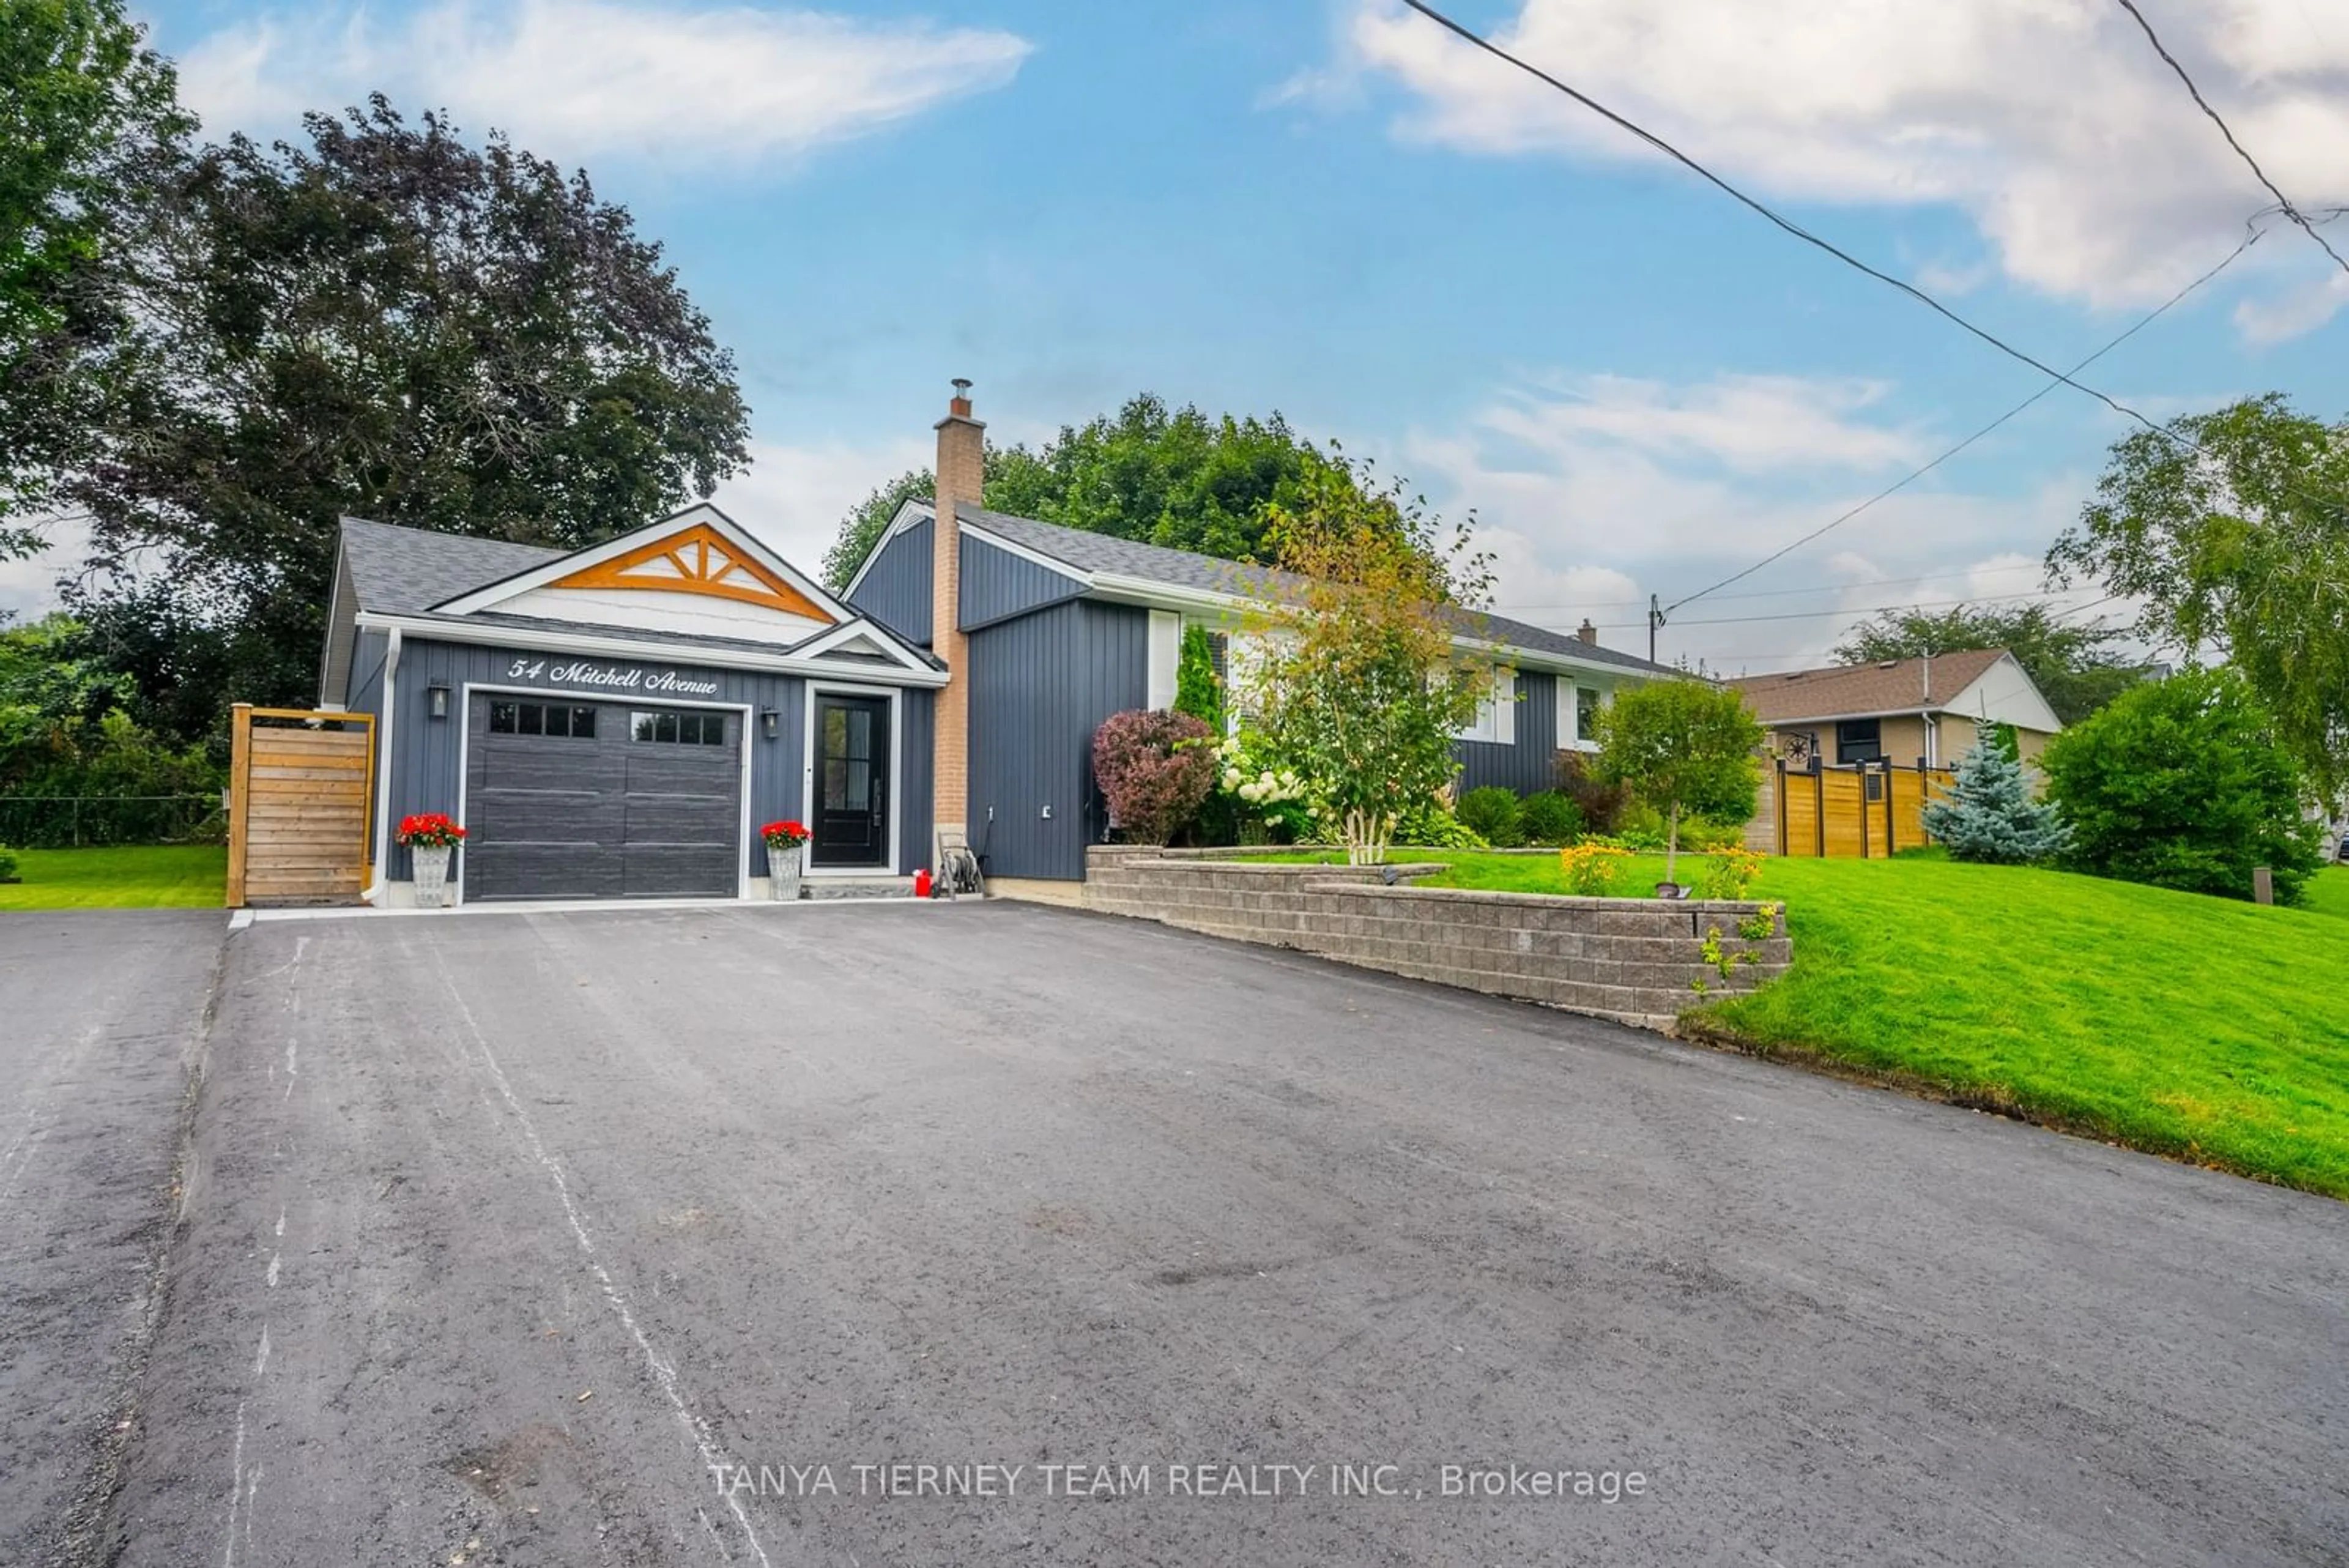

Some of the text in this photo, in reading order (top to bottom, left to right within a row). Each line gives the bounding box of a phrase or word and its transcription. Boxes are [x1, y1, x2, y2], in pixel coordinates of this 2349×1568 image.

[508, 659, 718, 694] 54 Mitchell Avenue
